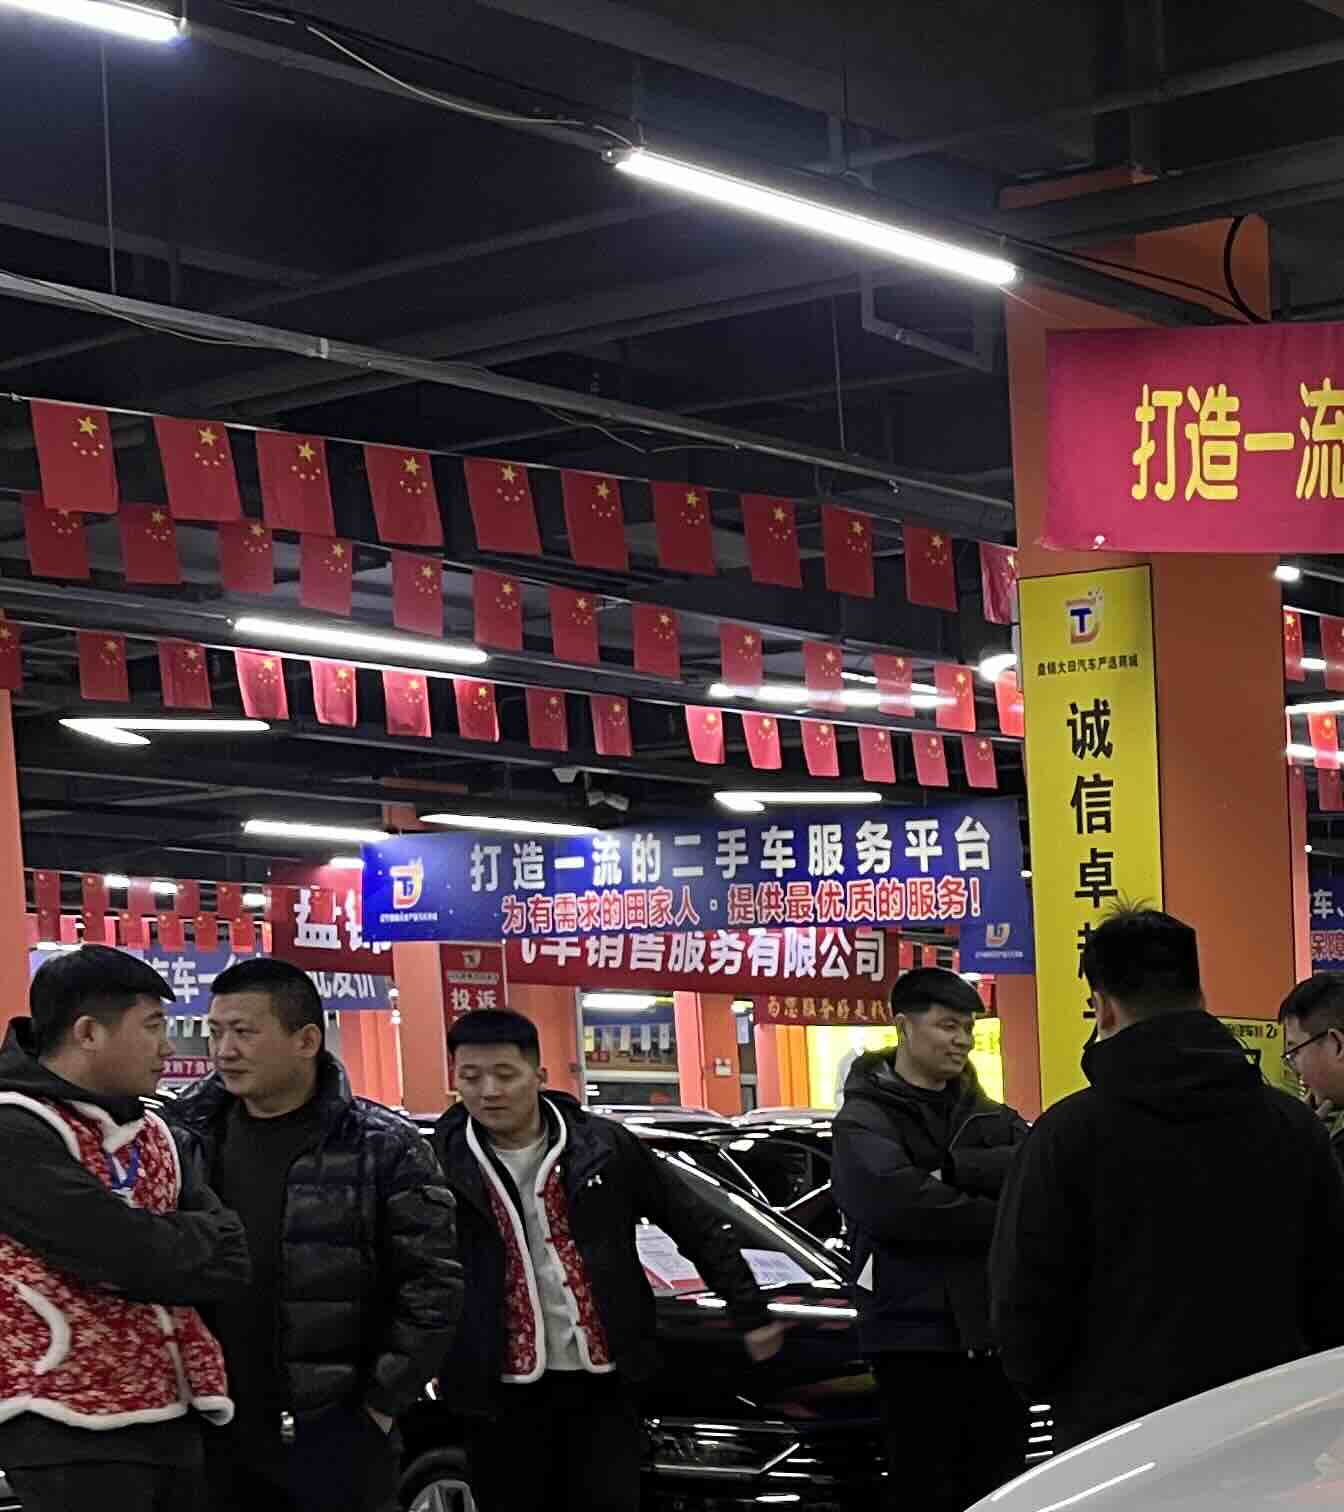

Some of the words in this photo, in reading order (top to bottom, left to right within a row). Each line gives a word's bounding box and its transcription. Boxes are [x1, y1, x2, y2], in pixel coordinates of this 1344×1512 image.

[470, 816, 992, 892] 打造一流的二手车服务平台
